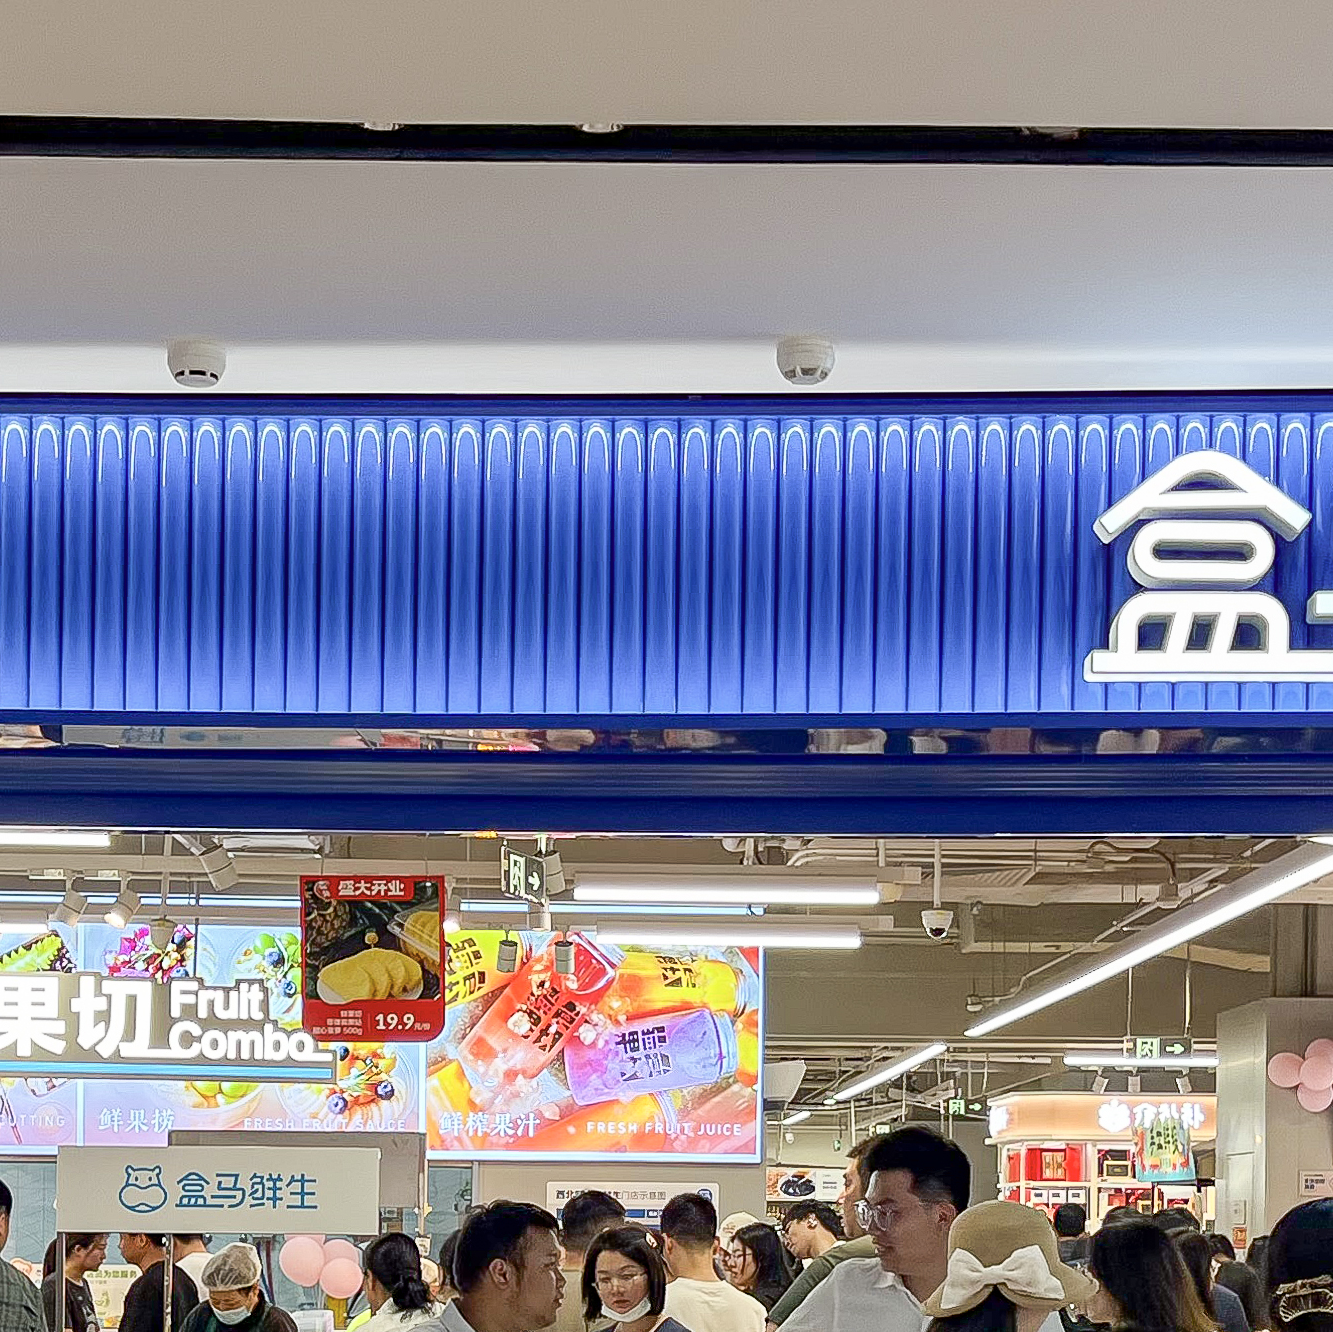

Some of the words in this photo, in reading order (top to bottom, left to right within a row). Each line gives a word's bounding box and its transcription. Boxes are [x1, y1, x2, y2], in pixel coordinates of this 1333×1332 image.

[338, 880, 405, 896] 盛大开业
[169, 980, 264, 1020] Fruit
[375, 1013, 415, 1030] 19.9
[169, 1020, 315, 1062] Combo
[98, 1107, 175, 1134] 鲜果捞
[244, 1118, 294, 1130] FRESH
[302, 1118, 348, 1130] FRUIT
[356, 1119, 406, 1131] SAUCE
[440, 1111, 540, 1137] 鲜榨果汁
[585, 1120, 638, 1134] FRESH
[644, 1121, 691, 1135] FRUIT
[696, 1123, 743, 1137] JUICE
[175, 1172, 318, 1209] 盒马鲜生
